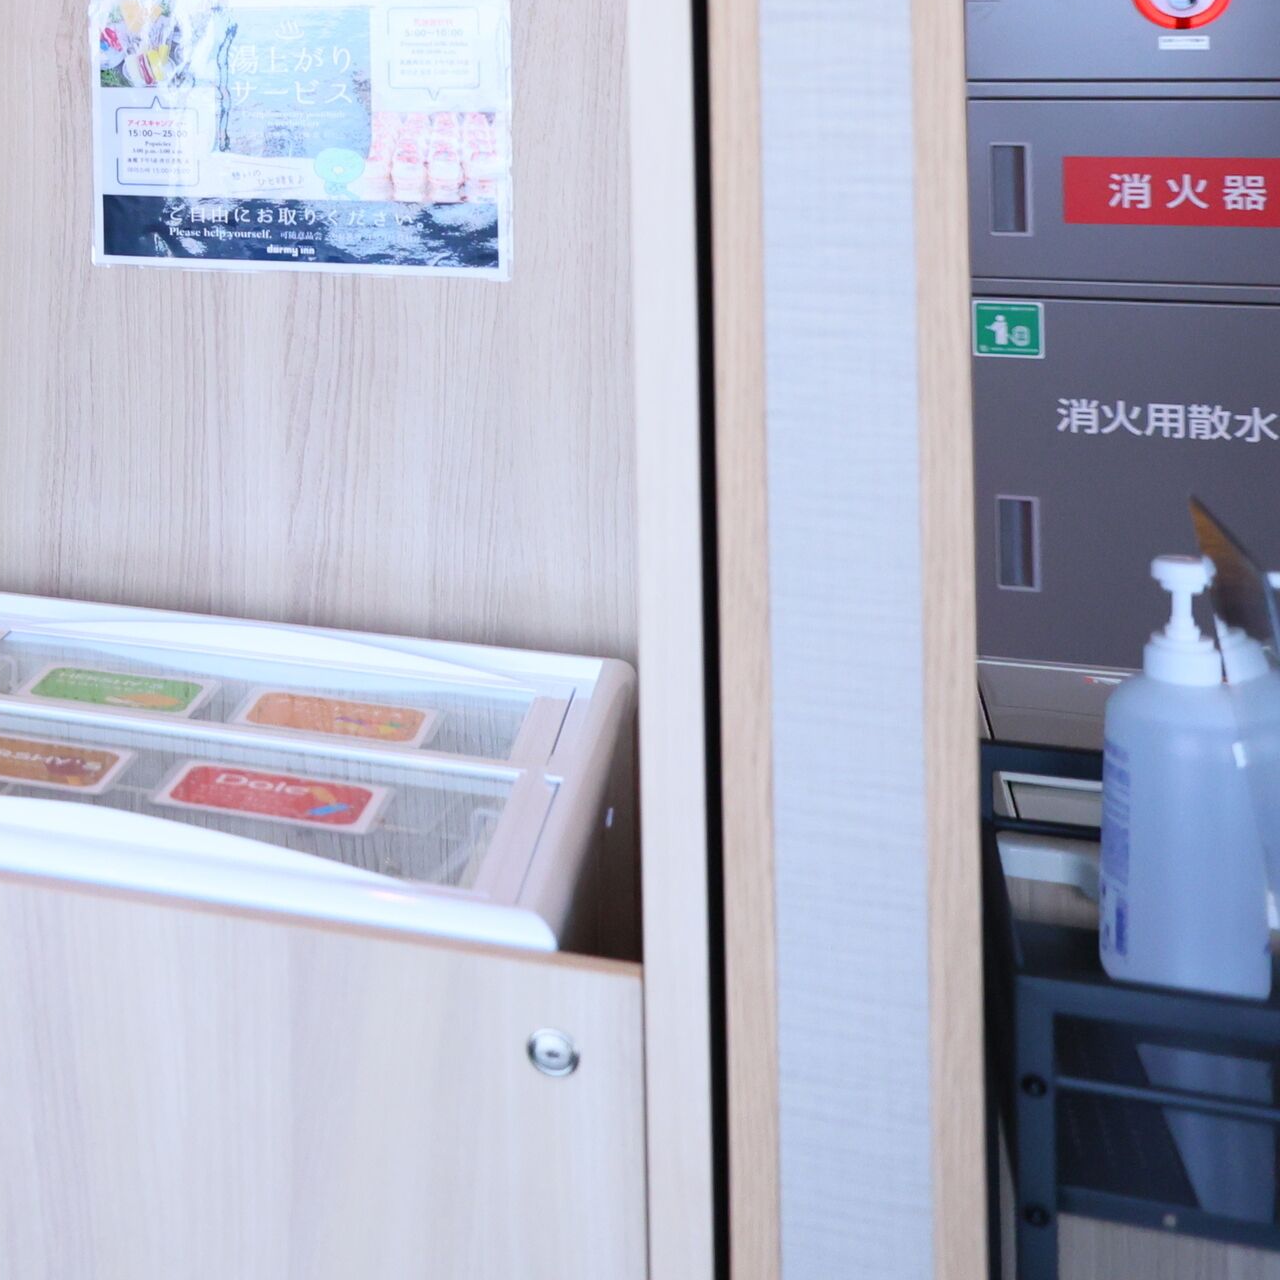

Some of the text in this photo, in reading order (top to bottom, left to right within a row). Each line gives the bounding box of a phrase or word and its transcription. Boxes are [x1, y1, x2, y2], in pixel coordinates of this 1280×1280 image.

[230, 44, 351, 74] 湯上がり
[231, 80, 352, 105] サービス
[1108, 173, 1268, 211] 消火器
[169, 226, 272, 241] Please help yourself.
[267, 244, 316, 257] dormy inn
[1056, 397, 1280, 443] 消火用散水
[215, 772, 310, 795] Dole
